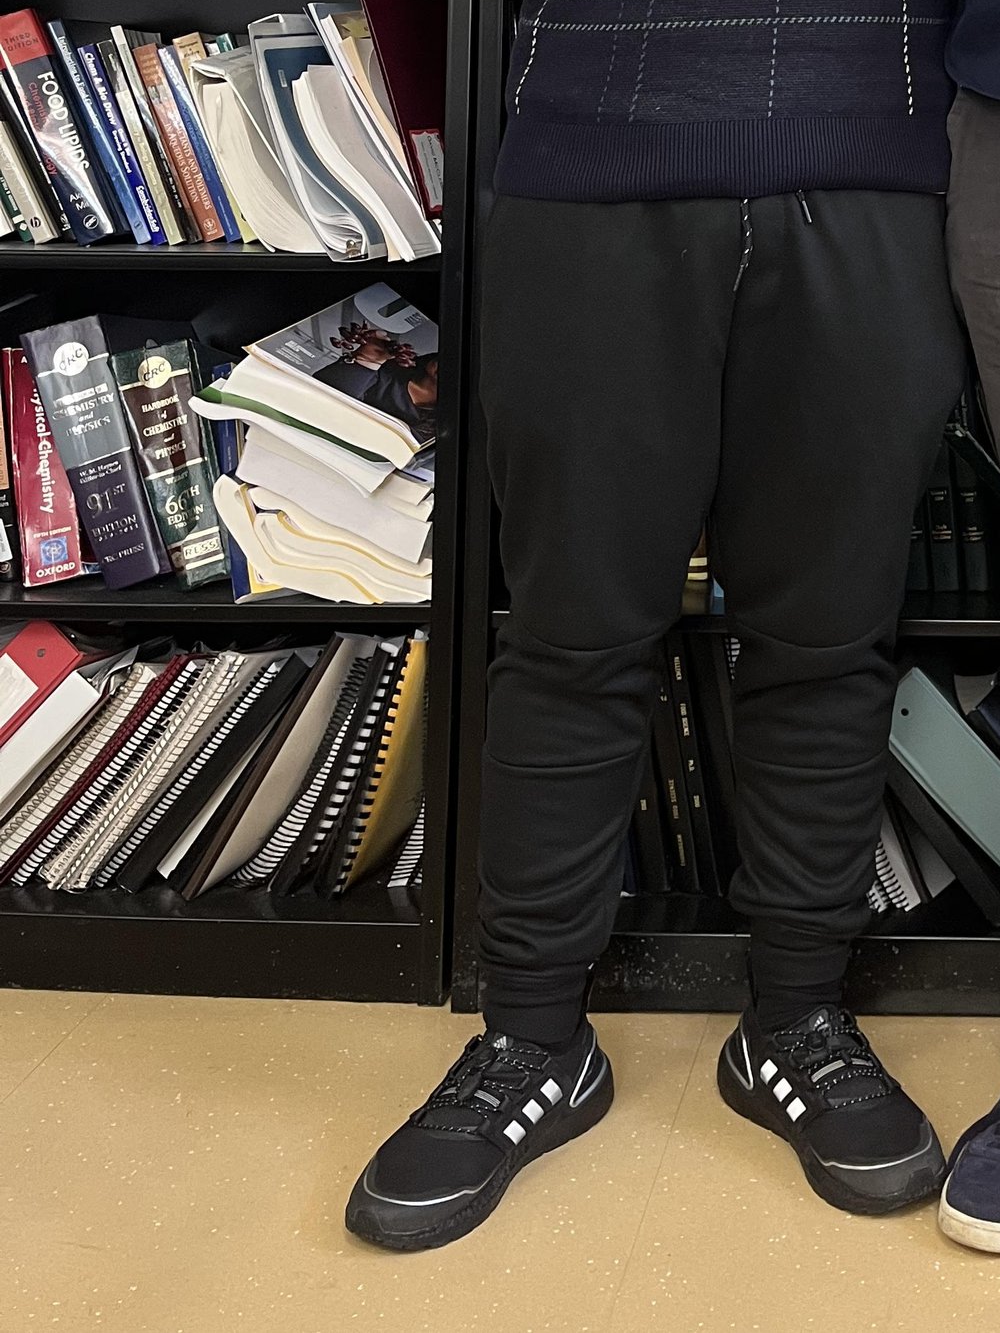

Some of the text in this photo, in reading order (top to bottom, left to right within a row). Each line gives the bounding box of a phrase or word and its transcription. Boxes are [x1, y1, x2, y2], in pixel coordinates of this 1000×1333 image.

[84, 52, 117, 125] Chem Bio Draw
[36, 71, 69, 122] FOOD
[57, 124, 90, 173] LIPIDS
[164, 123, 174, 133] IN
[167, 133, 187, 167] AQUEOUS
[180, 166, 199, 203] SOLUTION
[186, 158, 212, 210] AND POLYMERS
[136, 186, 160, 233] CambridgeSoft
[143, 363, 166, 383] CRC
[141, 394, 180, 413] HANDBOOK
[78, 412, 94, 422] and
[142, 414, 189, 437] CHEMISTRY
[155, 440, 187, 461] PHYSICS
[39, 442, 56, 514] Chemistry
[164, 485, 201, 516] 66TH
[33, 526, 72, 539] FIFTH EDITION
[91, 514, 137, 539] EDITION
[118, 542, 145, 559] PRESS
[35, 561, 76, 578] OXFORD
